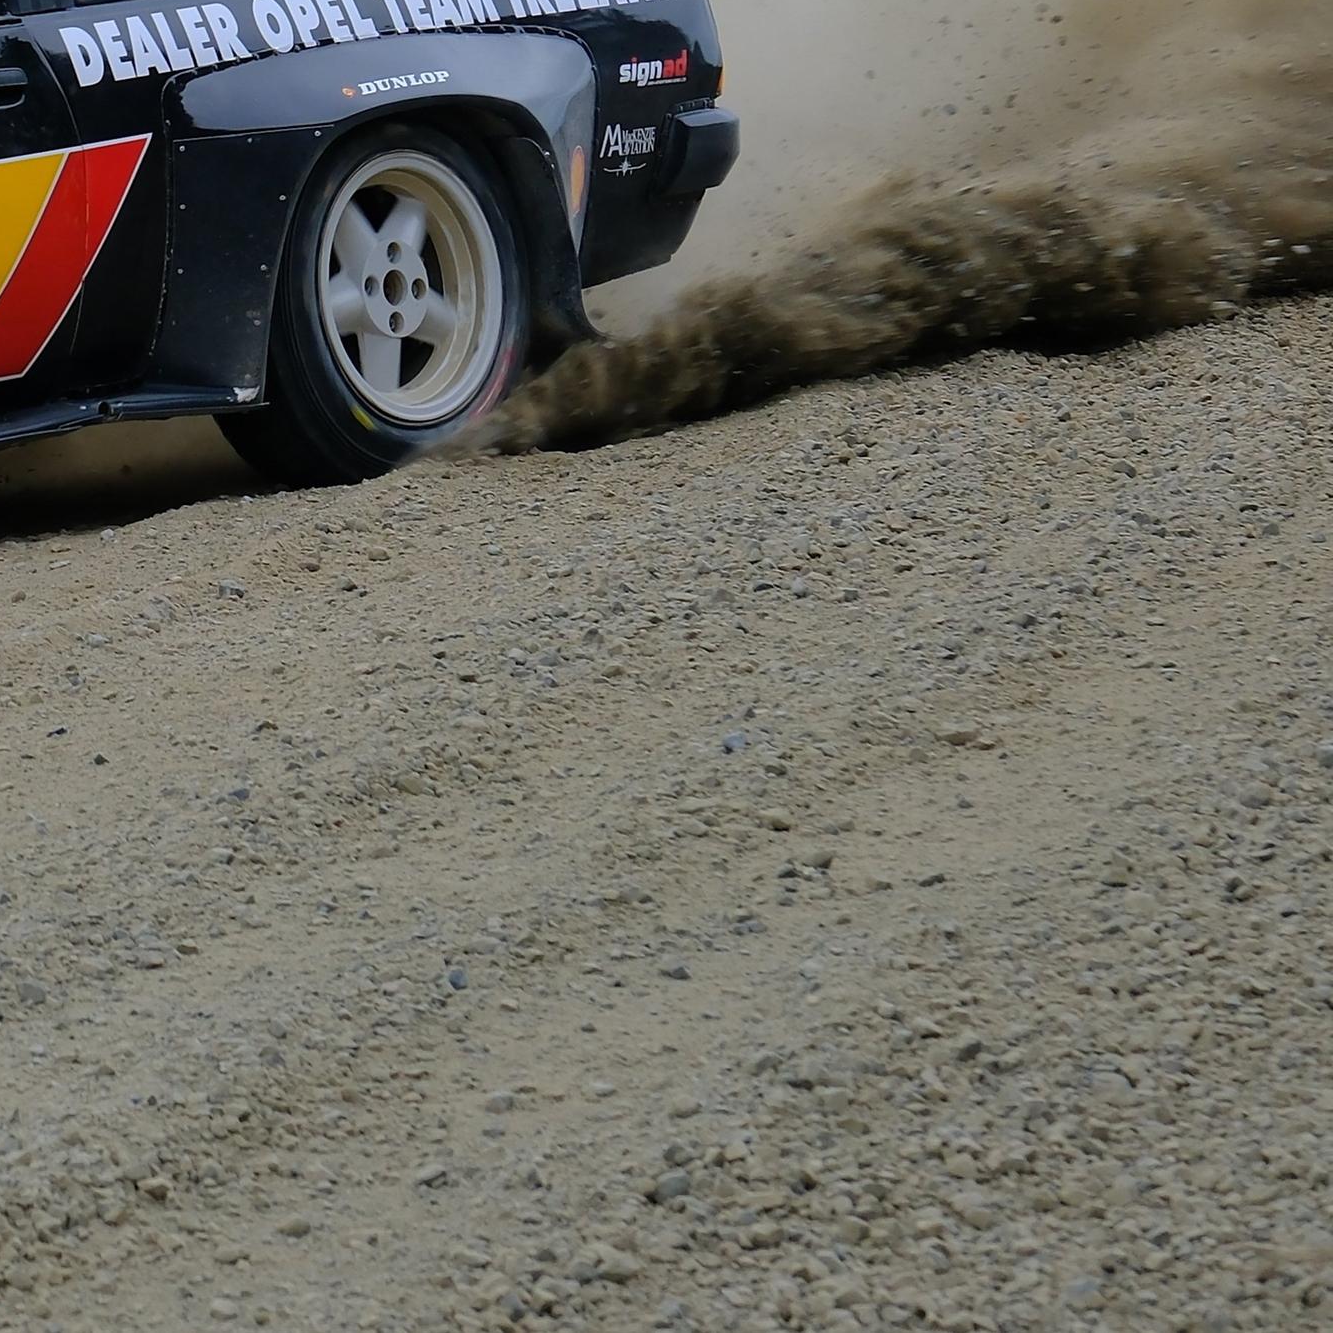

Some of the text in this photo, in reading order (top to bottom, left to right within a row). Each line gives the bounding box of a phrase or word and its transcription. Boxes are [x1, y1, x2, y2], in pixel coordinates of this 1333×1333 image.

[59, 2, 252, 87] DEALER
[358, 70, 450, 96] DUNLOP
[619, 49, 688, 87] signad
